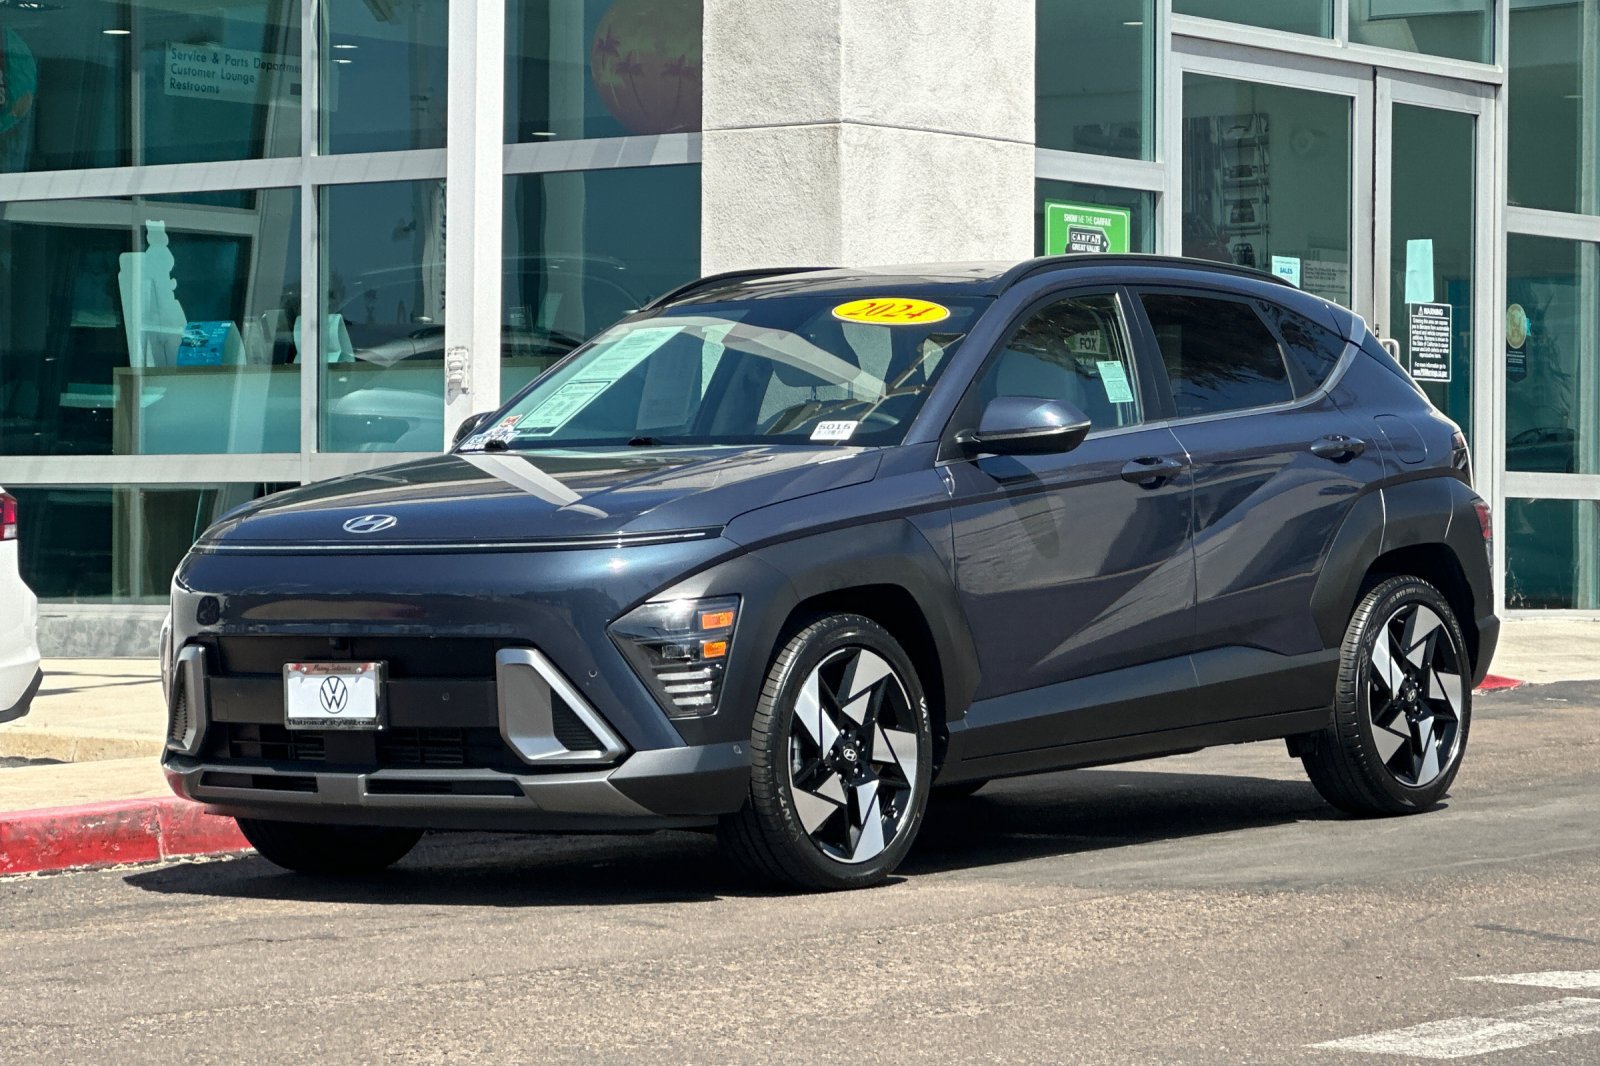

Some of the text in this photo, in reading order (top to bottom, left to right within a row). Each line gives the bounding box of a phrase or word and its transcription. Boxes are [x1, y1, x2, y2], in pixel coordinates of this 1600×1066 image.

[171, 48, 302, 74] Service & Parts Departme
[170, 63, 255, 85] Customer Lounge
[169, 78, 220, 94] Restrooms
[1064, 213, 1078, 223] SHOW
[1093, 217, 1112, 226] CARFAX
[1071, 232, 1101, 245] CARFAX
[1071, 243, 1100, 253] GREAT VALUE
[845, 303, 936, 318] 2024
[1080, 337, 1097, 352] FOX
